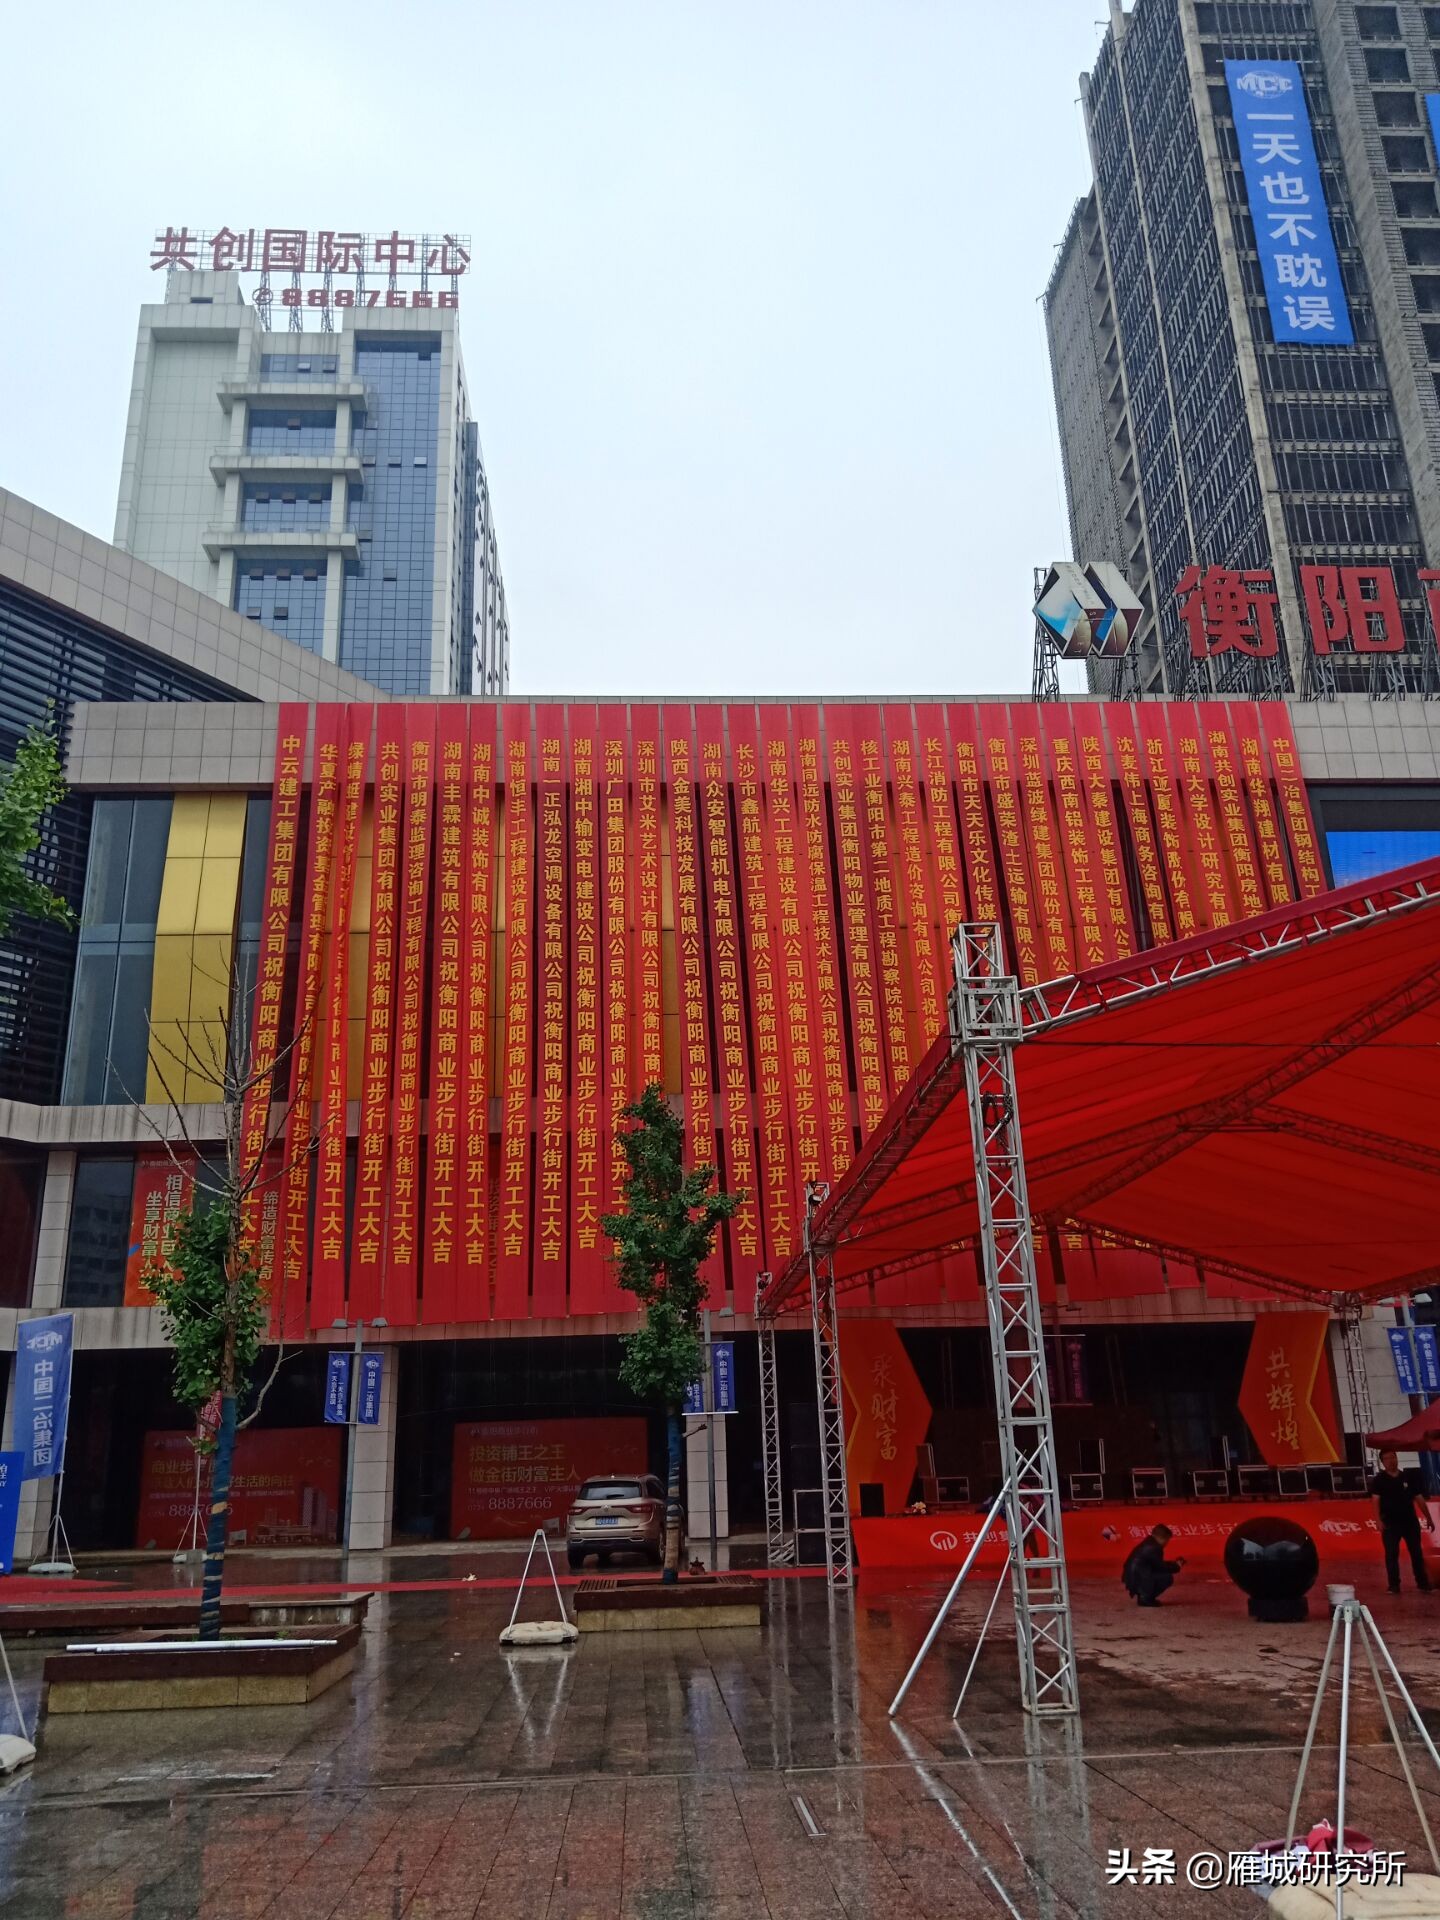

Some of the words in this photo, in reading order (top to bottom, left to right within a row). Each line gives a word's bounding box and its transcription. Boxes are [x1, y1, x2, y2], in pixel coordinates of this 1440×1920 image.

[150, 227, 471, 275] 共创国际中心
[1246, 112, 1336, 332] 一天也不耽误
[1176, 564, 1440, 658] 衡阳
[860, 740, 910, 1099] 核工业衡阳市第二地质工程勘察院祝衡阳商
[1020, 737, 1070, 980] 深圳蓝波绿建集团股份有限公
[1116, 737, 1170, 947] 沈麦伟上海商务咨询有限
[358, 742, 400, 1264] 共创实业集团有限公司祝衡阳商业步行街开工大吉
[432, 742, 462, 1264] 湖南丰霖建筑有限公司祝衡阳商业步行街开工大吉
[503, 741, 527, 1256] 湖南恒丰工程建设有限公司祝衡阳商业步行街开工大吉
[259, 1190, 279, 1280] 缔造财富传奇
[488, 1496, 552, 1511] 8887666
